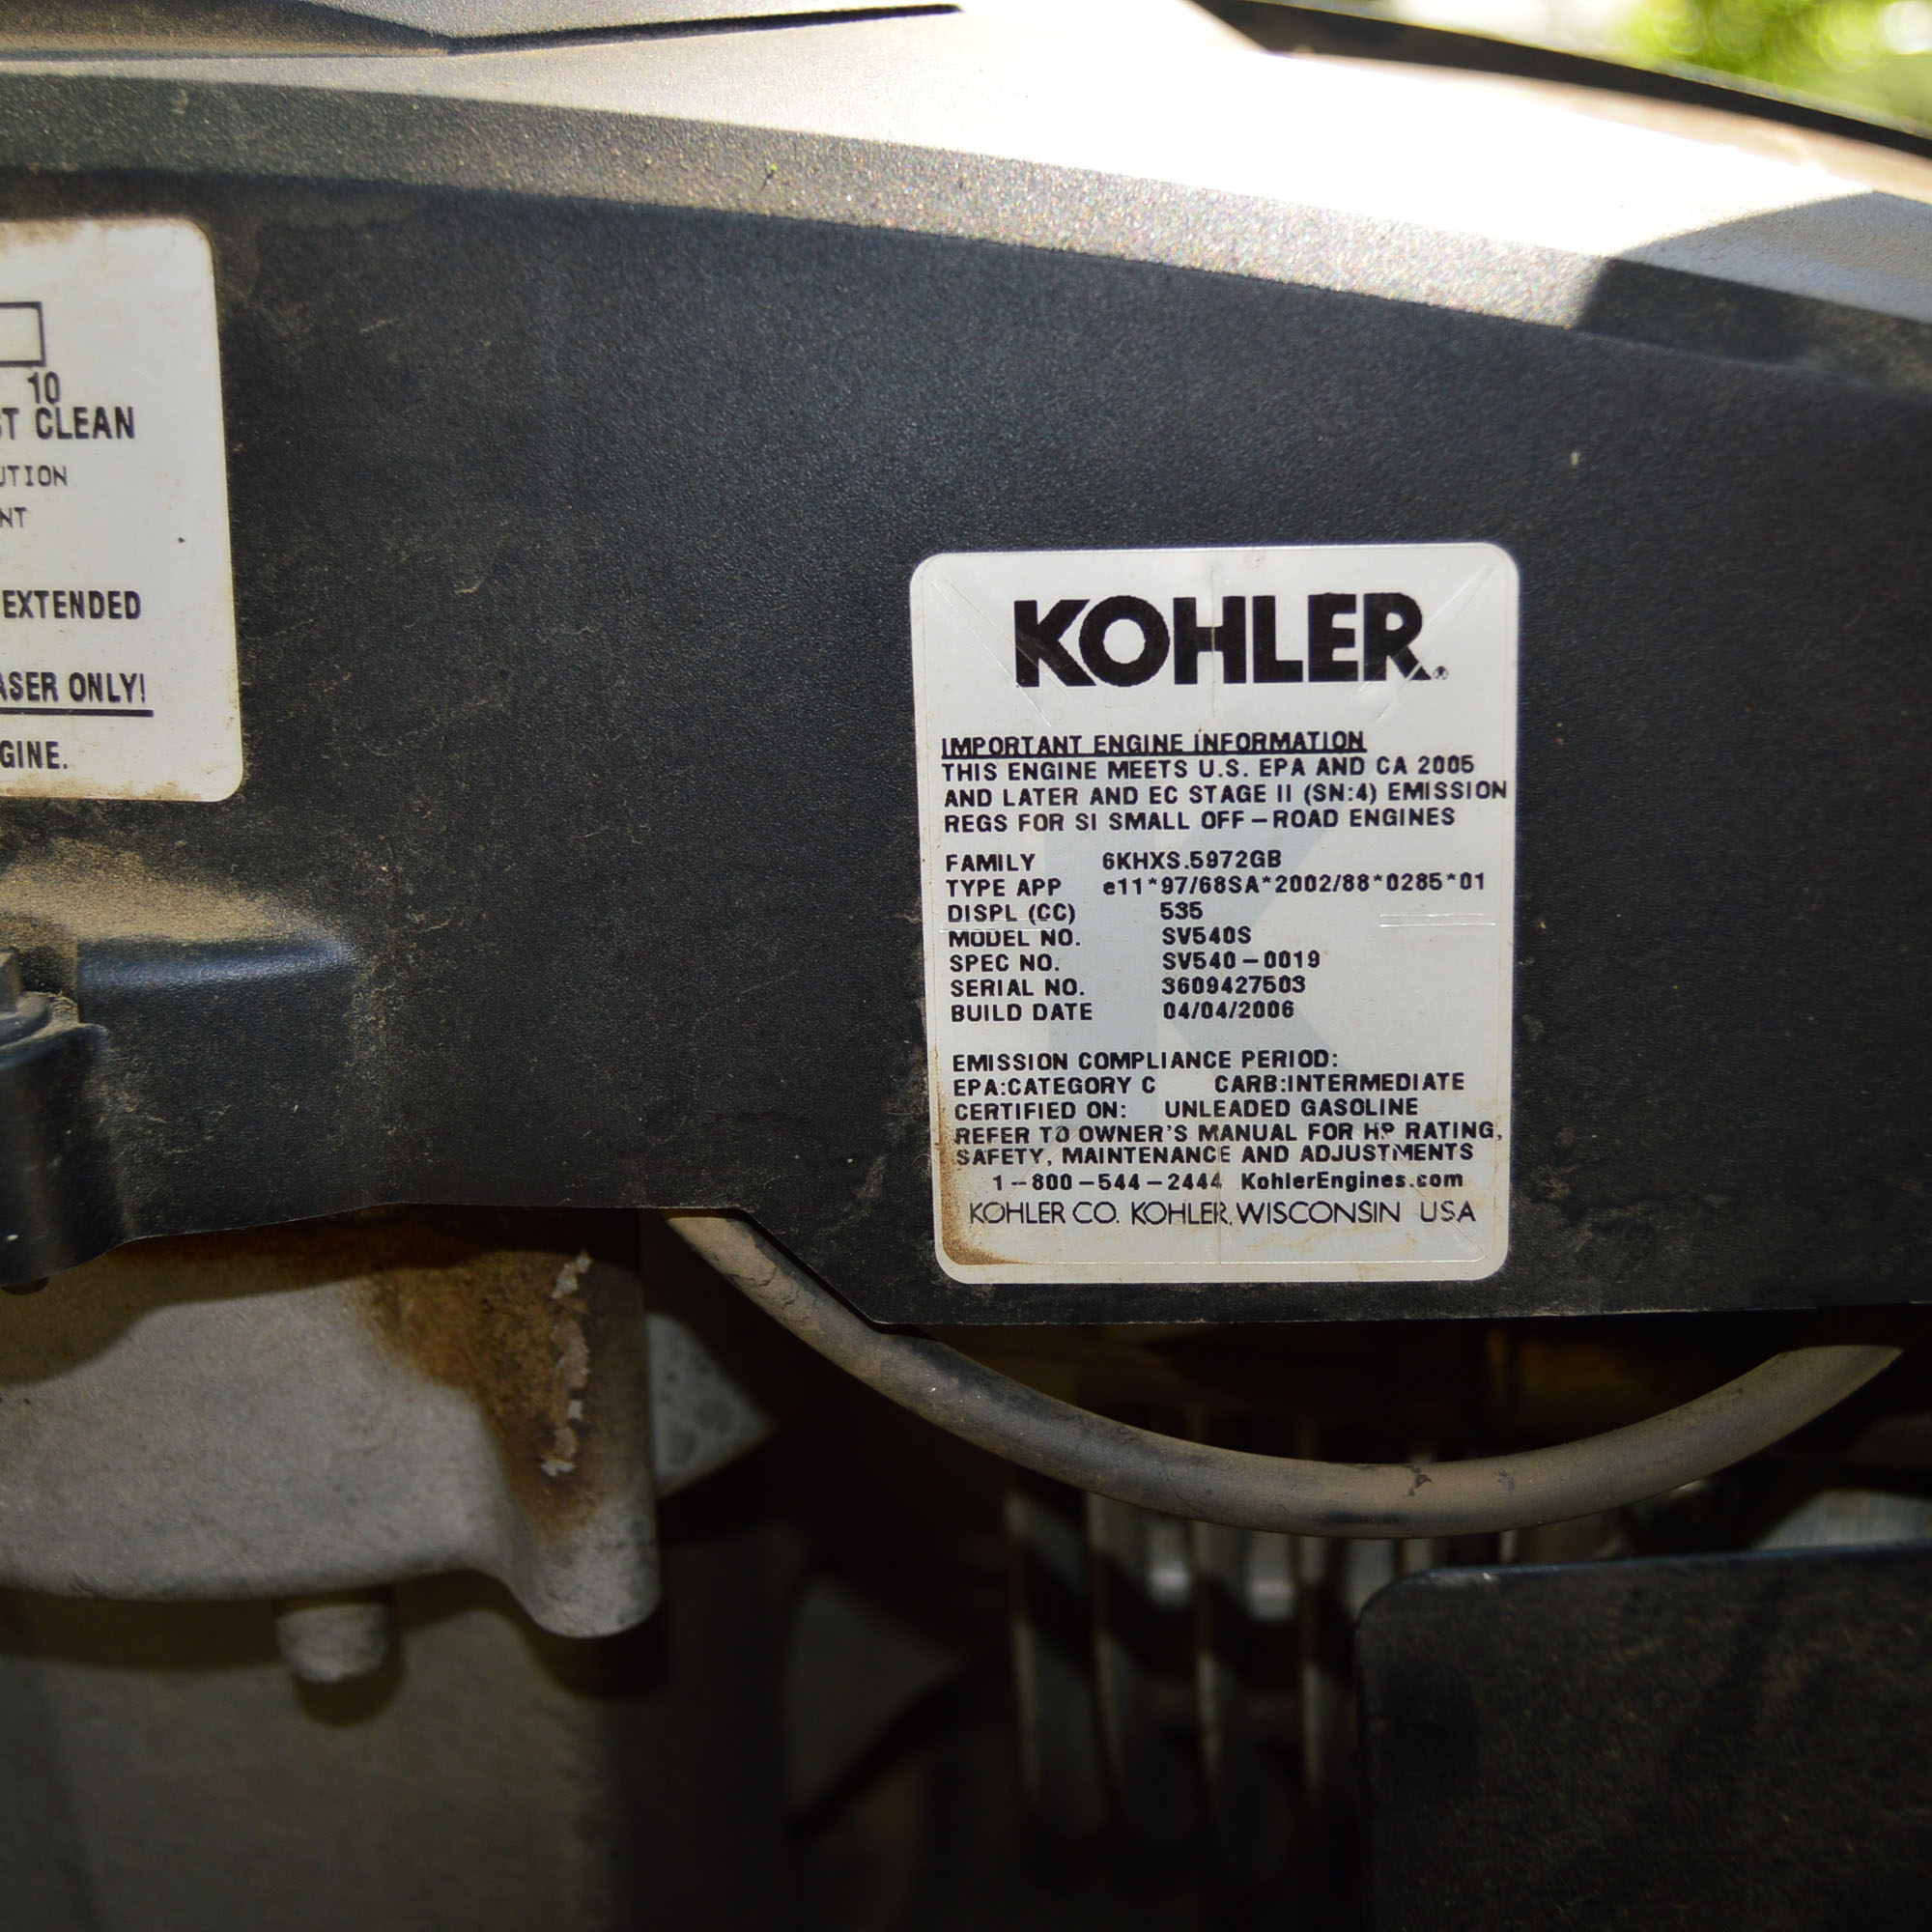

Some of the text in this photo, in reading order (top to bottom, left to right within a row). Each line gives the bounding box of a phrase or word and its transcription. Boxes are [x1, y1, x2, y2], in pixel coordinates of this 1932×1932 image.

[27, 371, 60, 406] 10
[0, 406, 134, 440] T CLEAN
[2, 589, 141, 620] EXTENDED
[69, 671, 145, 703] ONLY!
[0, 739, 69, 770] GINE.
[941, 730, 1368, 760] IMPORTANT ENGINE INFORMATION
[941, 754, 1474, 782] THIS ENGINE MEETS U.S. EPA AND CA 2005
[944, 780, 1507, 808] AND LATER AND EC STAGE II (SN:4) EMISSION
[944, 813, 1008, 834] REGS
[1018, 812, 1065, 833] FOR
[1075, 812, 1096, 832] SI
[1108, 811, 1190, 831] SMALL
[1350, 807, 1455, 828] ENGINES
[946, 849, 1282, 872] FAMILY 6KHXS.5972GB
[945, 878, 1006, 897] TYPE
[1016, 877, 1062, 896] APP
[948, 900, 1204, 925] DISPL (CC) 535
[948, 925, 1252, 948] MODEL NO. SV540S
[950, 950, 1321, 973] SPEC NO. SV540-0019
[950, 975, 1306, 998] SERIAL NO. 3609427503
[951, 999, 1294, 1023] BUILD DATE 04/04/2006
[952, 1048, 1338, 1072] EMISSION COMPLIANCE PERIOD:
[953, 1071, 1464, 1097] EPA:CATEGORY C CARB:INTERMEDIATE
[954, 1096, 1418, 1122] CERTIFIED ON: UNLEADED GASOLINE
[952, 1121, 1502, 1146] REFER TO OWNER'S MANUAL FOR HP RATING,
[956, 1142, 1474, 1167] SAFETY, MAINTENANCE AND ADJUSTMENTS
[1241, 1170, 1463, 1193] KohlerEngines.com
[969, 1201, 1066, 1224] KOHLER
[1072, 1201, 1120, 1224] CO.
[1236, 1200, 1401, 1225] WISCONSIN
[1420, 1200, 1477, 1223] USA
